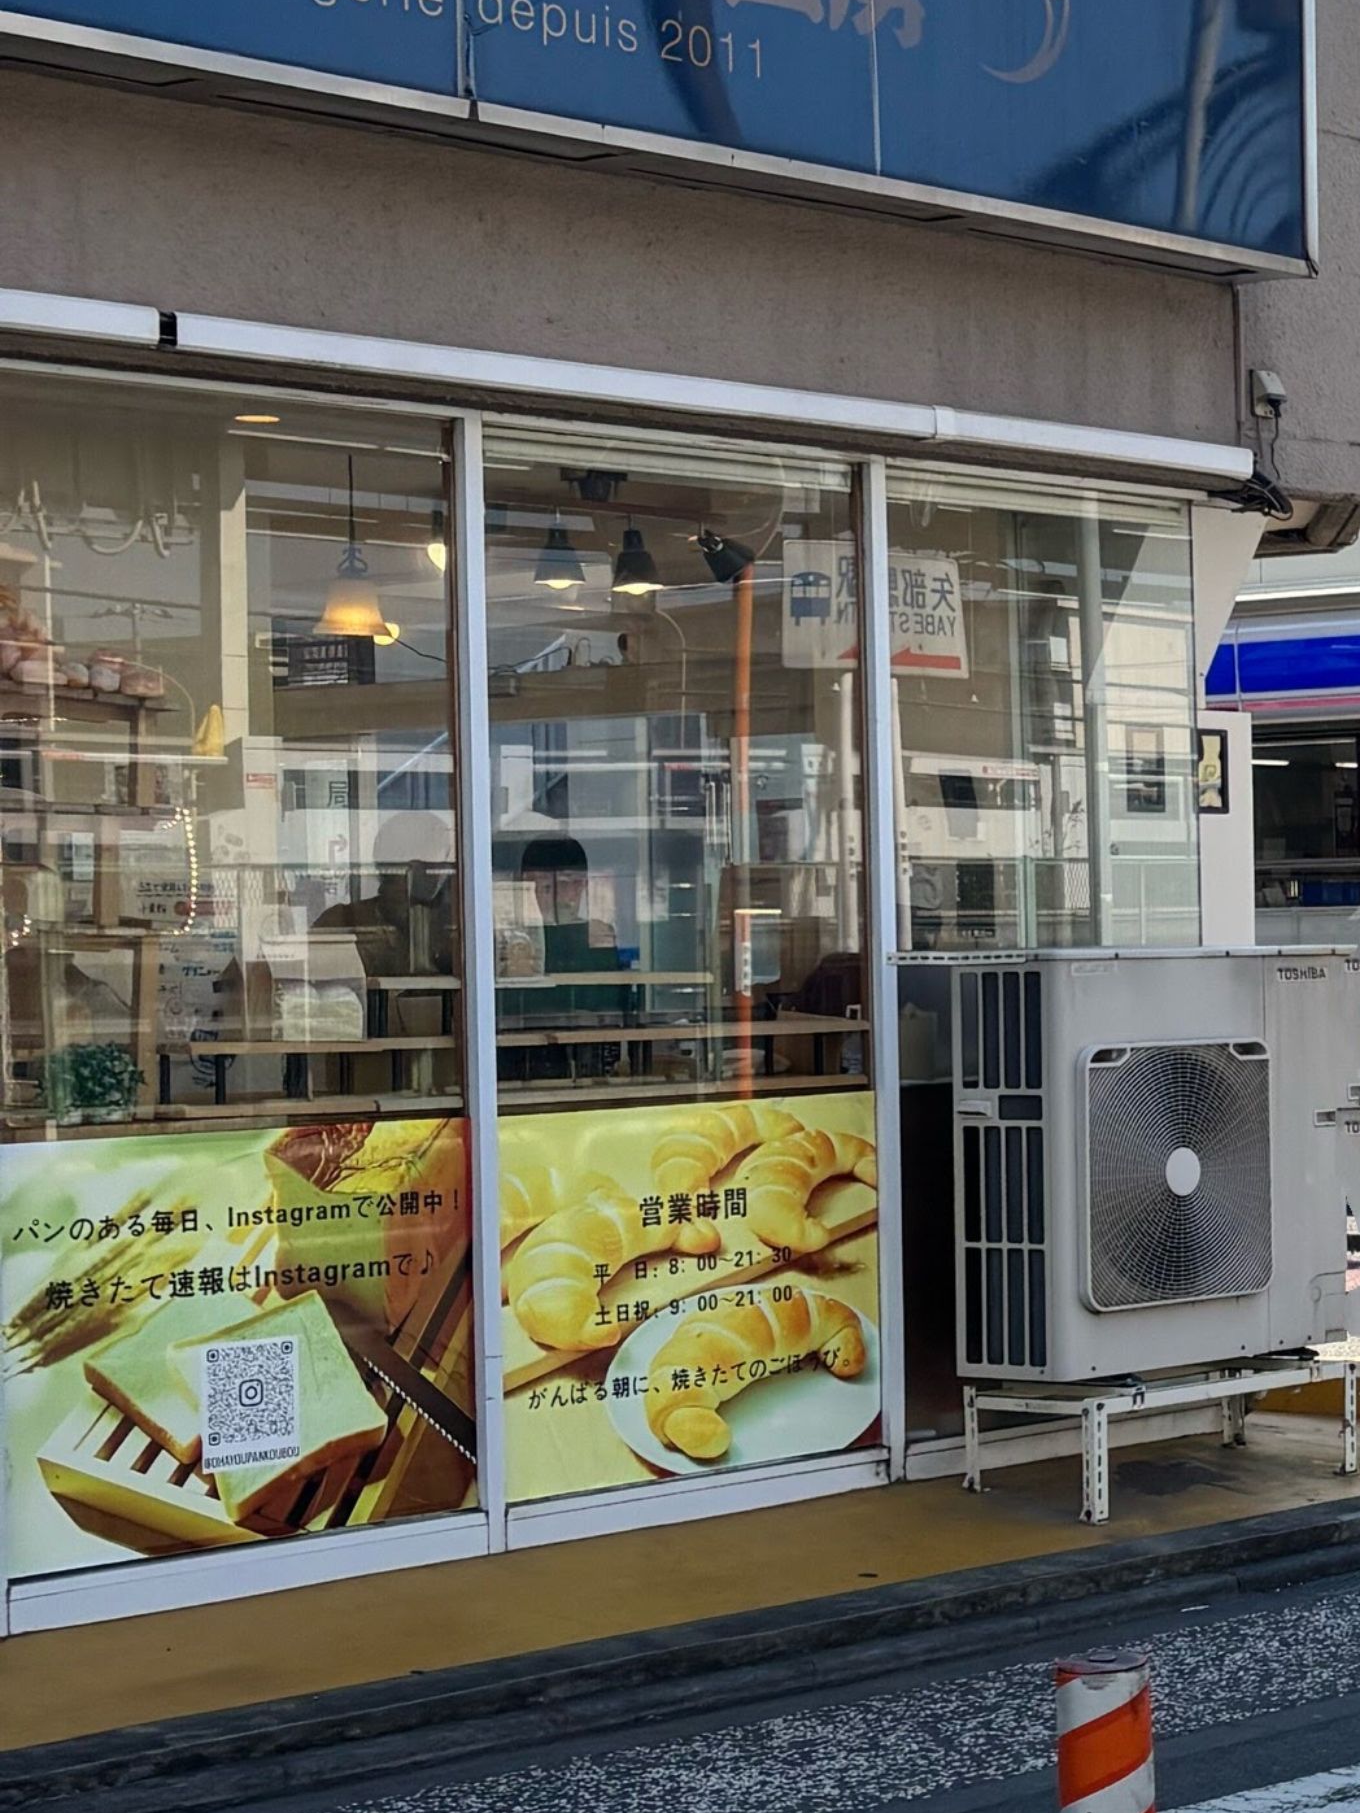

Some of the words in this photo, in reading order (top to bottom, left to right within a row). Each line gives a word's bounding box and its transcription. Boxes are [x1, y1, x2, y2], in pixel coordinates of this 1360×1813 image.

[658, 18, 764, 80] 2011
[1277, 967, 1326, 981] TOSHIBA
[639, 1187, 748, 1228] 営業時間
[528, 1346, 851, 1410] がんばる朝に、焼きたてのごほうび。
